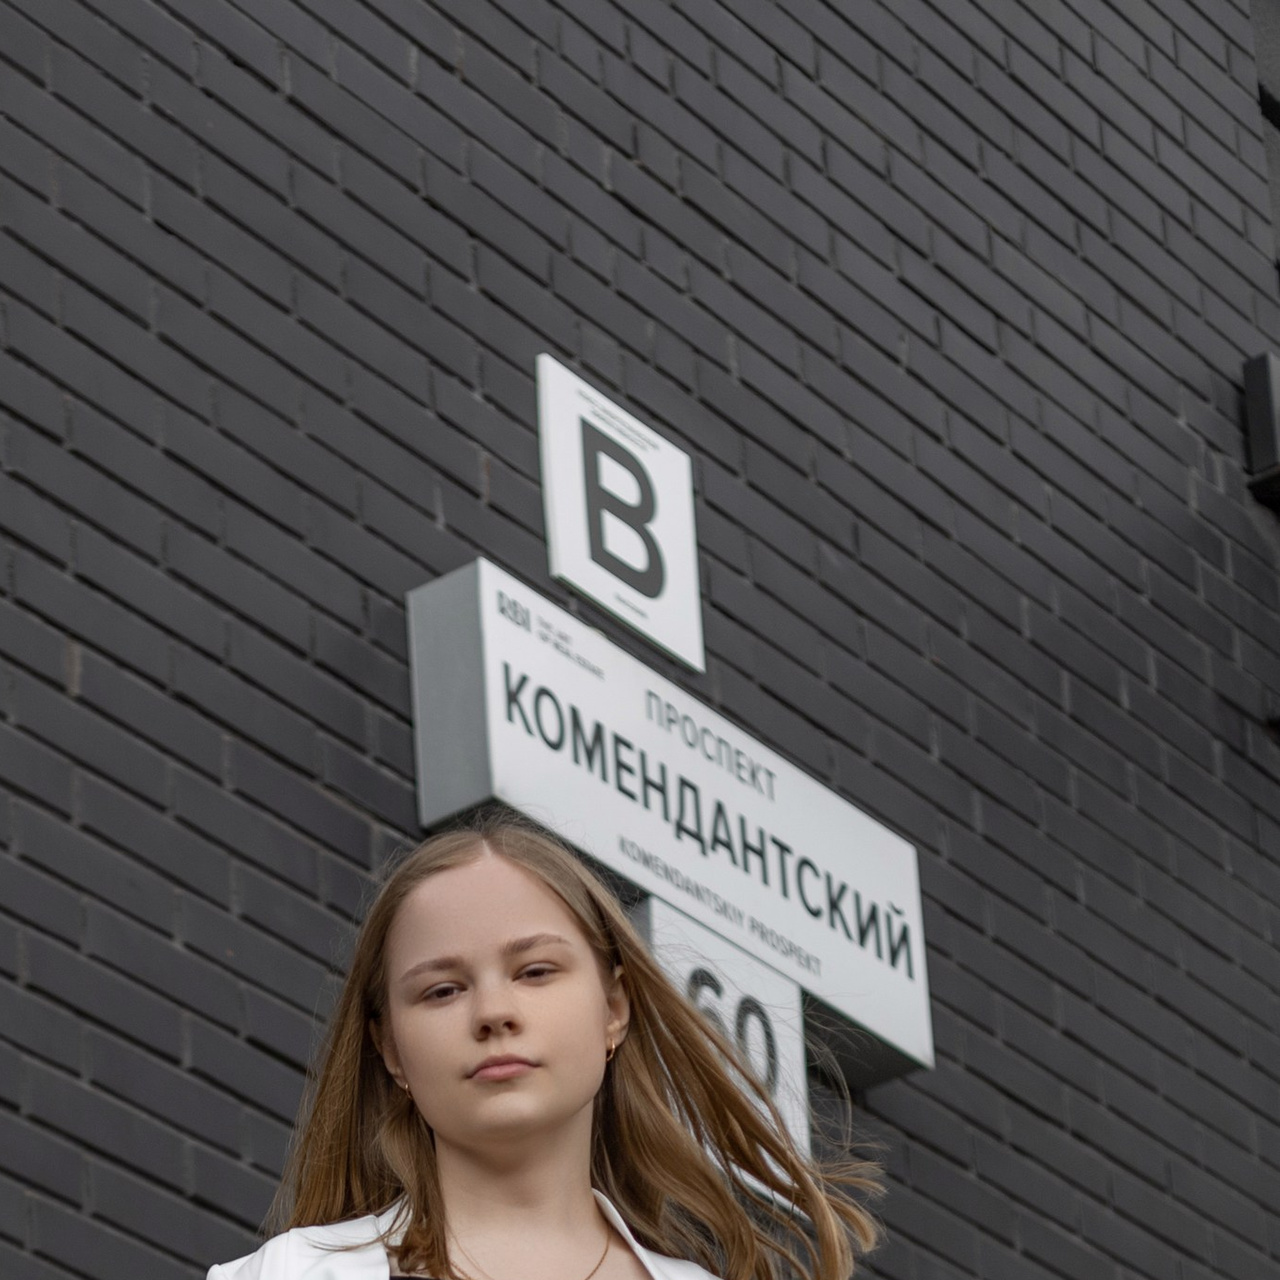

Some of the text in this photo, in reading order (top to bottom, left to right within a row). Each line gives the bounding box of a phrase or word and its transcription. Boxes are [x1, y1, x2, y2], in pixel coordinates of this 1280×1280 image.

[646, 688, 776, 802] ПРОСПЕКТ
[502, 660, 916, 983] КОМЕНДАНТСКИЙ
[618, 835, 822, 977] KOMENDANTSKIY PROSPEKT
